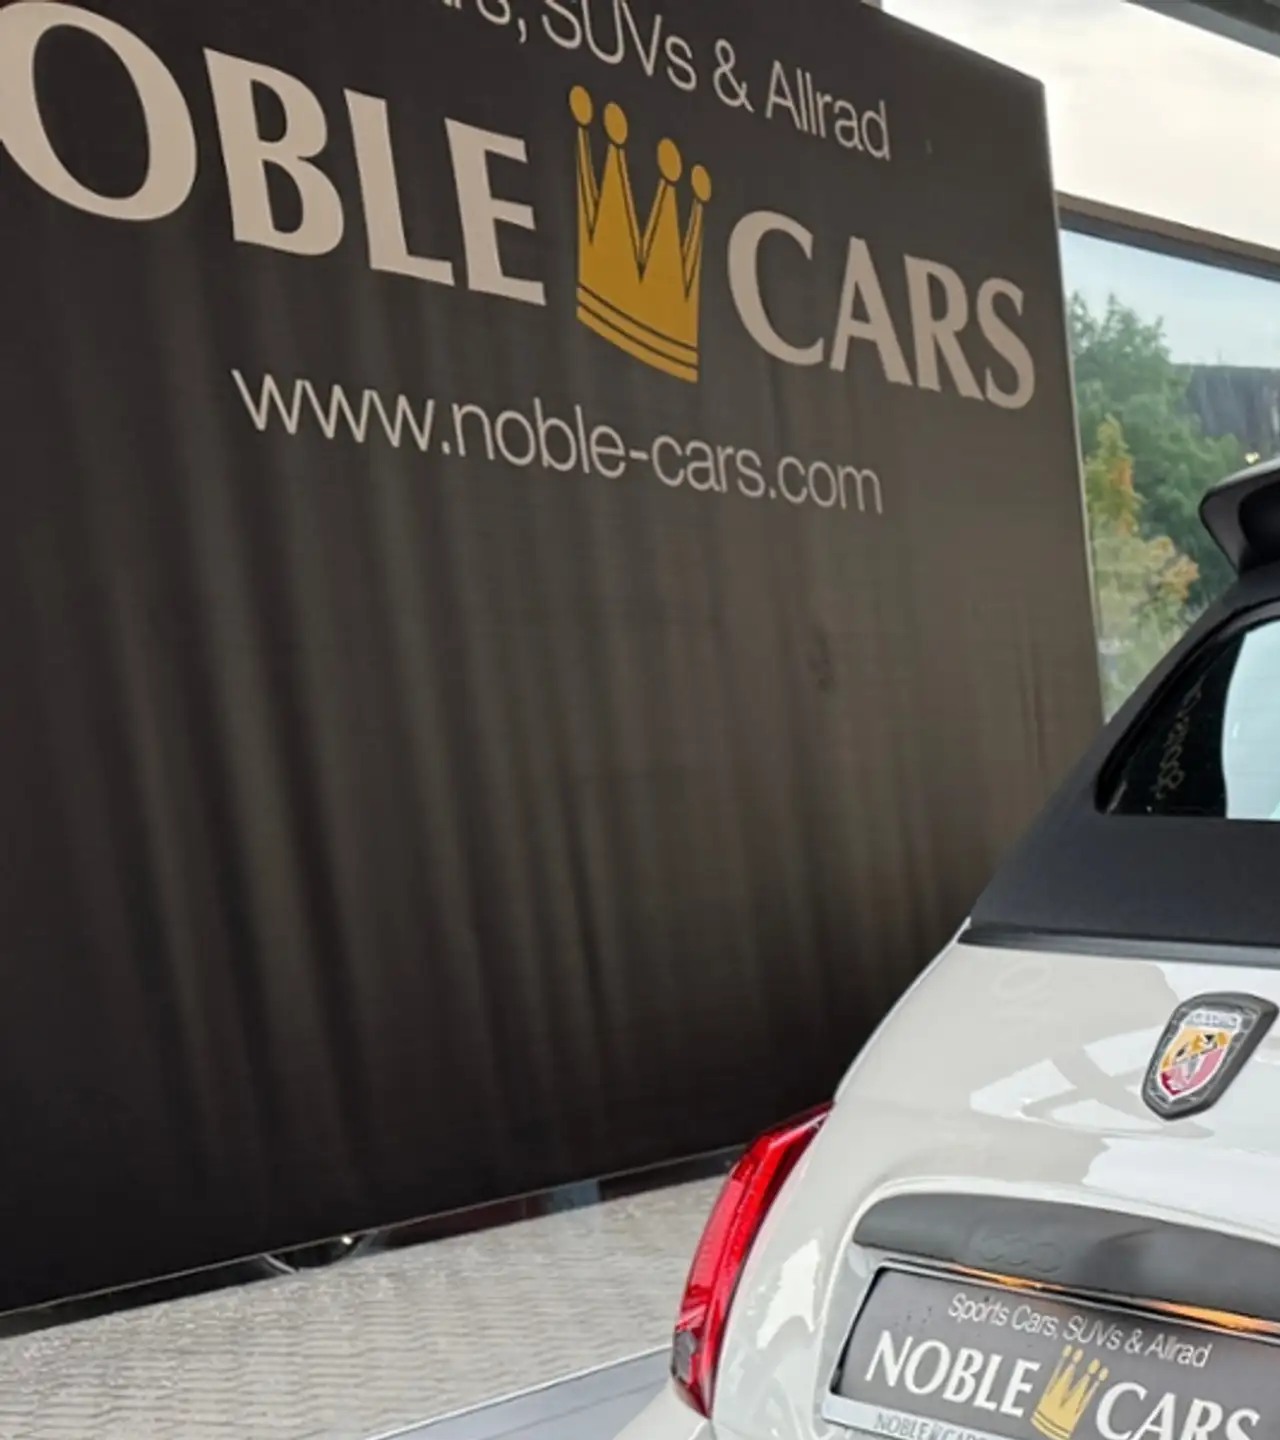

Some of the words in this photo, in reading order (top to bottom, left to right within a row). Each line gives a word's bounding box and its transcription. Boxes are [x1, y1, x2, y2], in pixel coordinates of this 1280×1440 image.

[713, 39, 755, 113] &
[765, 59, 892, 162] Allrad
[727, 210, 1035, 408] CARS
[230, 368, 883, 515] www.noble-cars.com
[865, 1330, 1040, 1418] NOBLE
[948, 1292, 1010, 1325] Sports
[1011, 1304, 1059, 1340] Cars,
[1063, 1315, 1123, 1351] SUVs
[1124, 1329, 1143, 1354] &
[1144, 1333, 1213, 1369] Allrad
[873, 1412, 932, 1440] NOBLE
